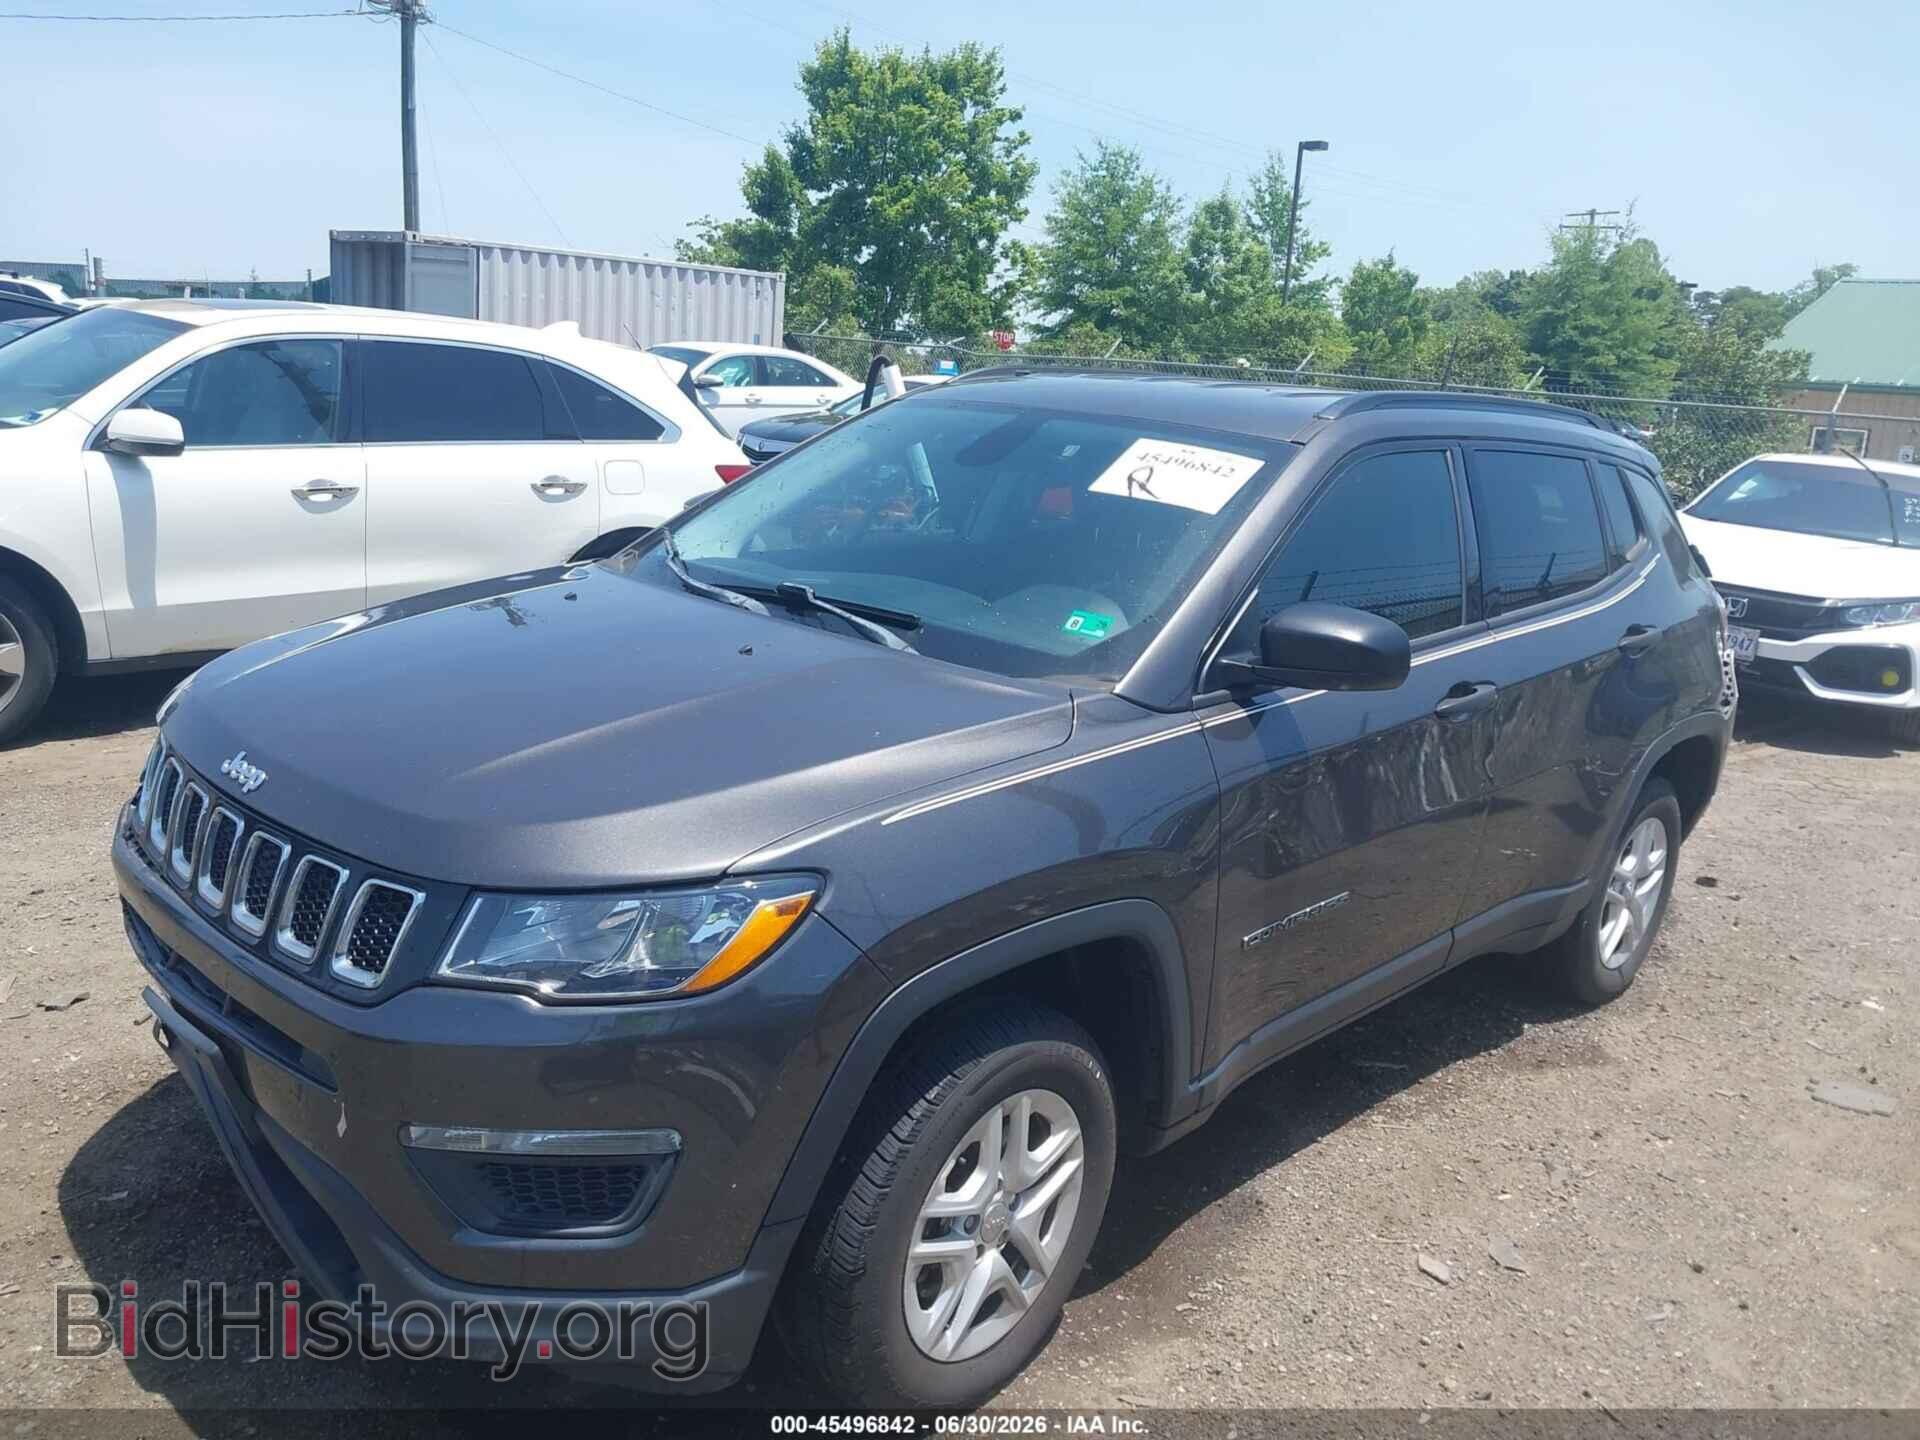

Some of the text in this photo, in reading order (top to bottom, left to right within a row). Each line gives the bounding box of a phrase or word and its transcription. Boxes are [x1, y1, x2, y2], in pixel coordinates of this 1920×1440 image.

[994, 331, 1014, 342] STOP
[1137, 453, 1236, 478] 45496842
[1126, 465, 1160, 499] R
[220, 750, 268, 794] Jeep
